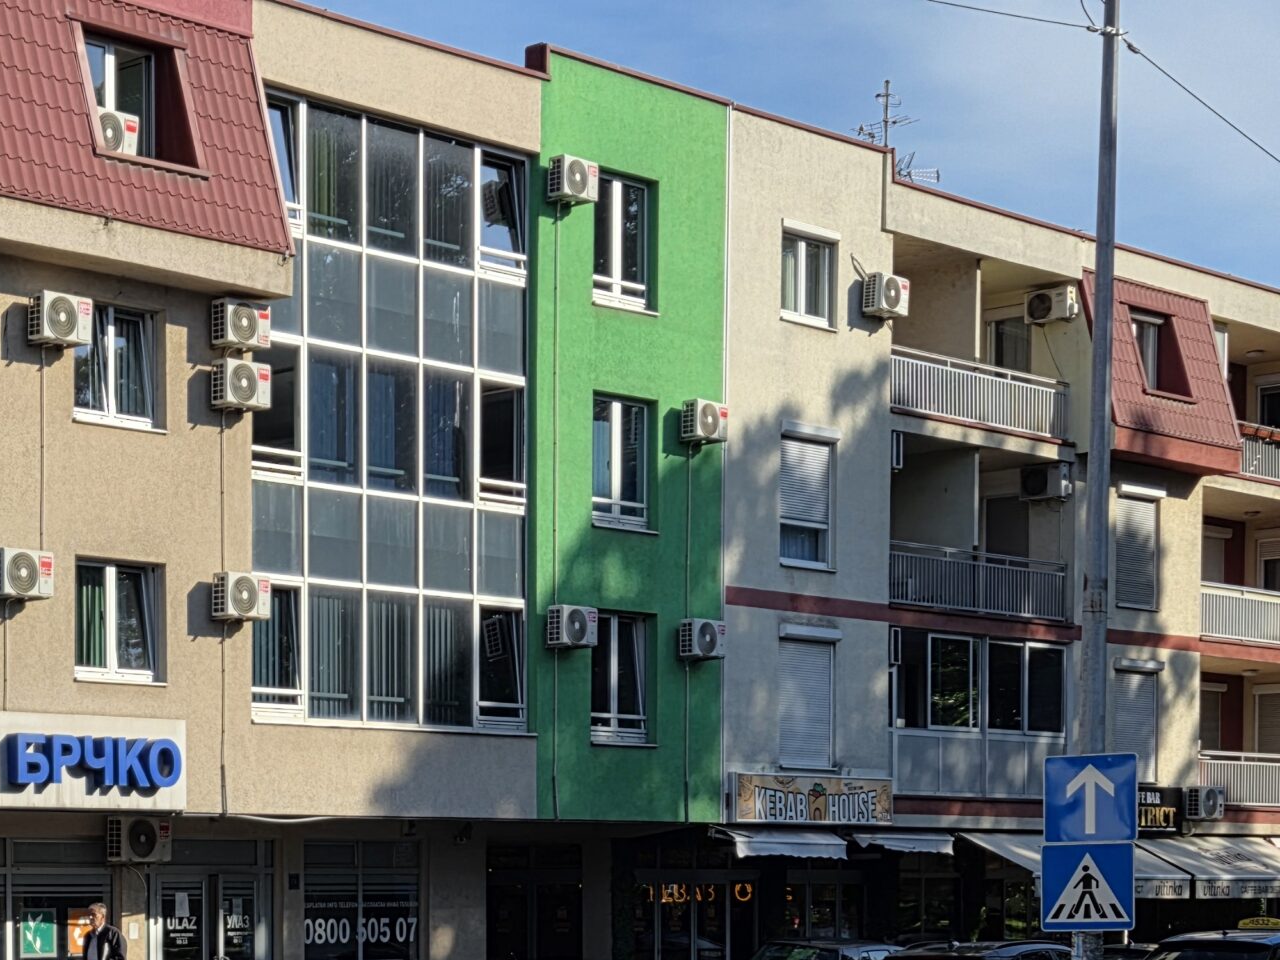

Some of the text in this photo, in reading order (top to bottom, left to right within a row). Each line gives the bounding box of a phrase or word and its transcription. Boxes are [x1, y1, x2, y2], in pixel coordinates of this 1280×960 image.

[14, 732, 183, 788] БРЧКО
[754, 785, 878, 822] KEBAB HOUSE
[1146, 792, 1161, 804] BAR
[1138, 806, 1177, 827] TRICT
[166, 916, 198, 930] ULAZ
[304, 918, 350, 944] 0800
